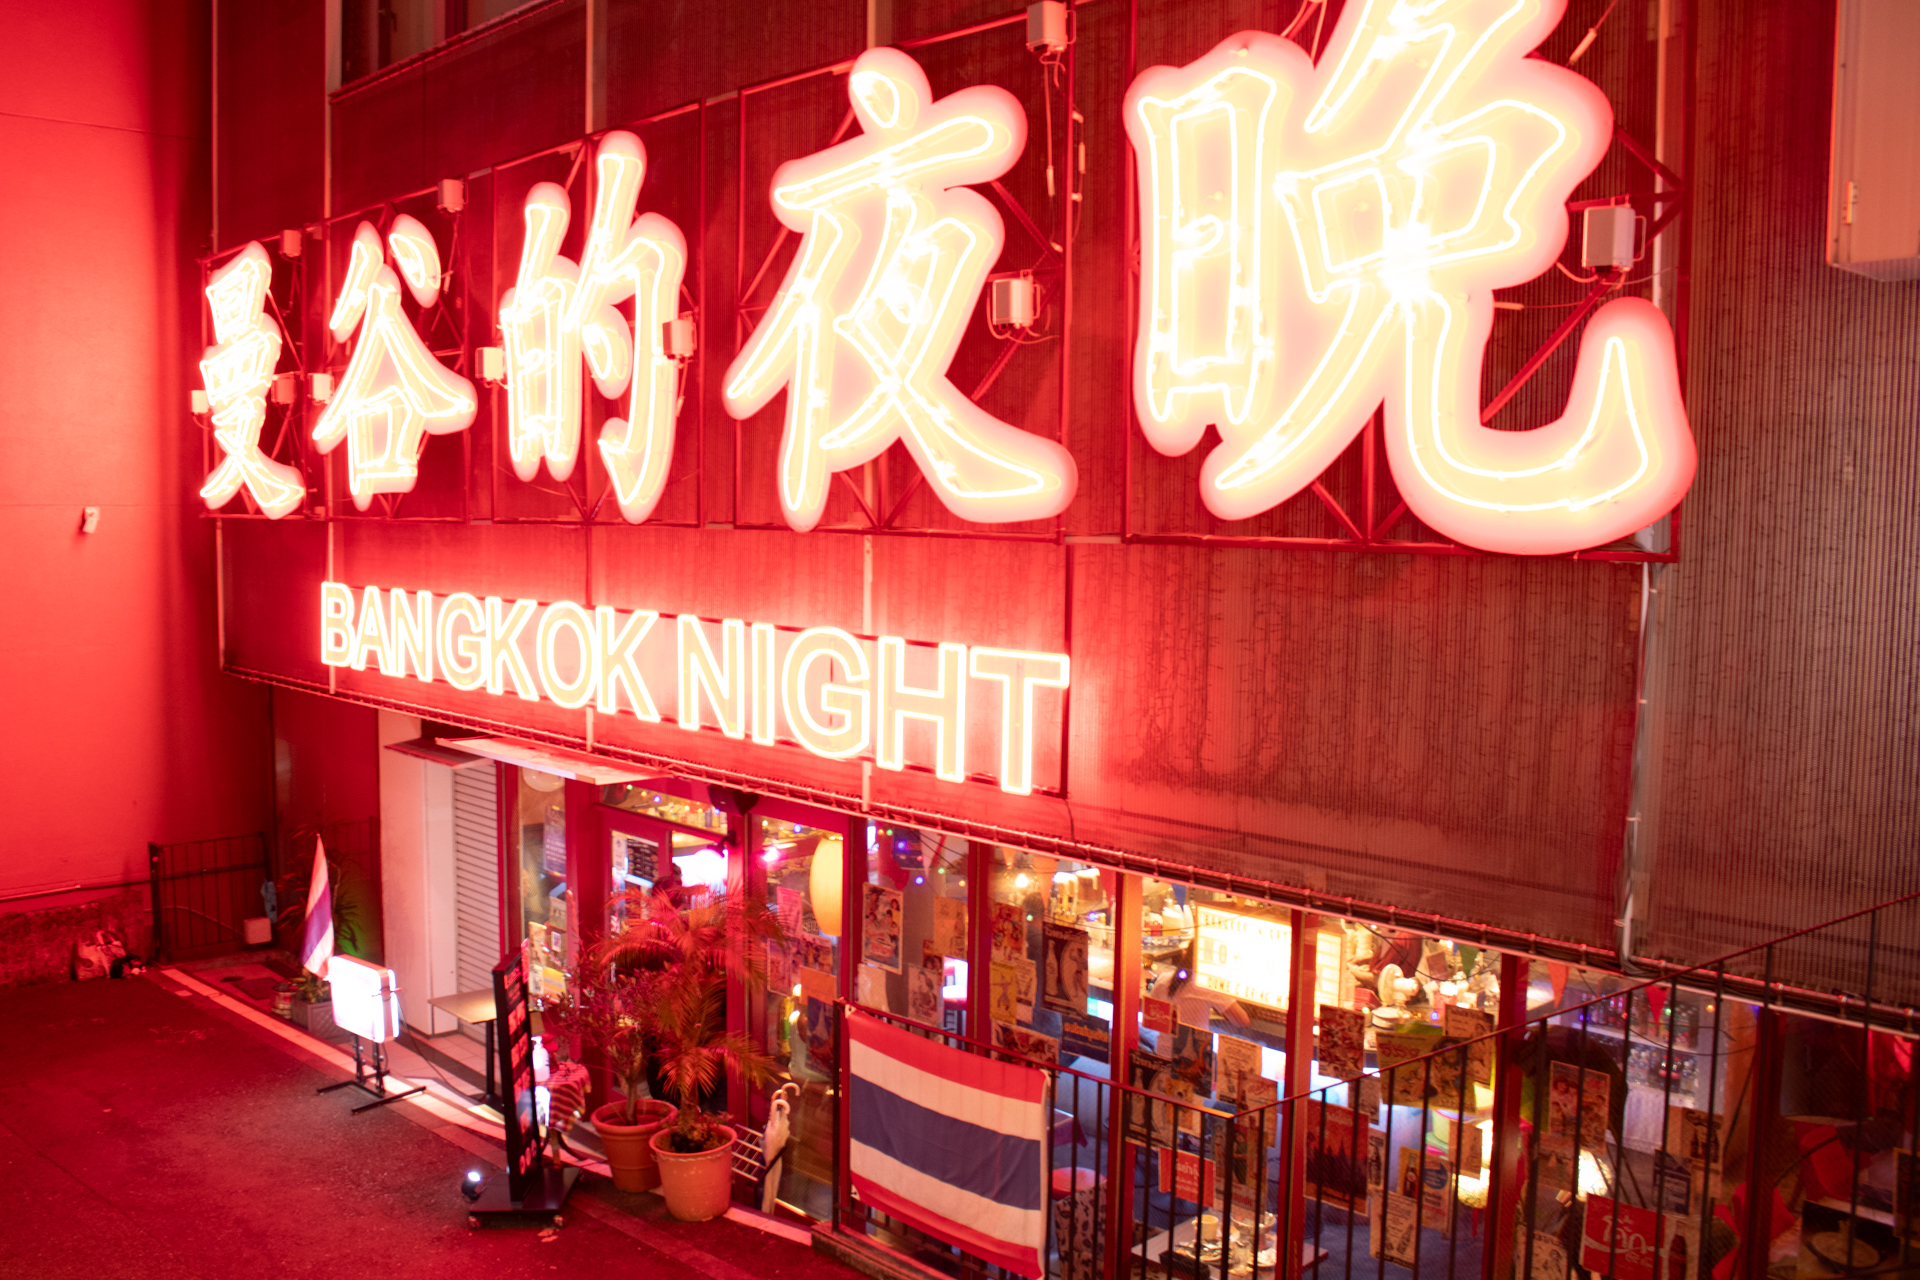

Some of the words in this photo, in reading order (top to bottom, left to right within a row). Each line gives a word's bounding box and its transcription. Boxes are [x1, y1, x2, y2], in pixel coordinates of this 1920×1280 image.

[198, 0, 1698, 557] 曼谷的夜晚
[320, 580, 661, 723] BANGKOK
[677, 613, 1071, 796] NIGHT
